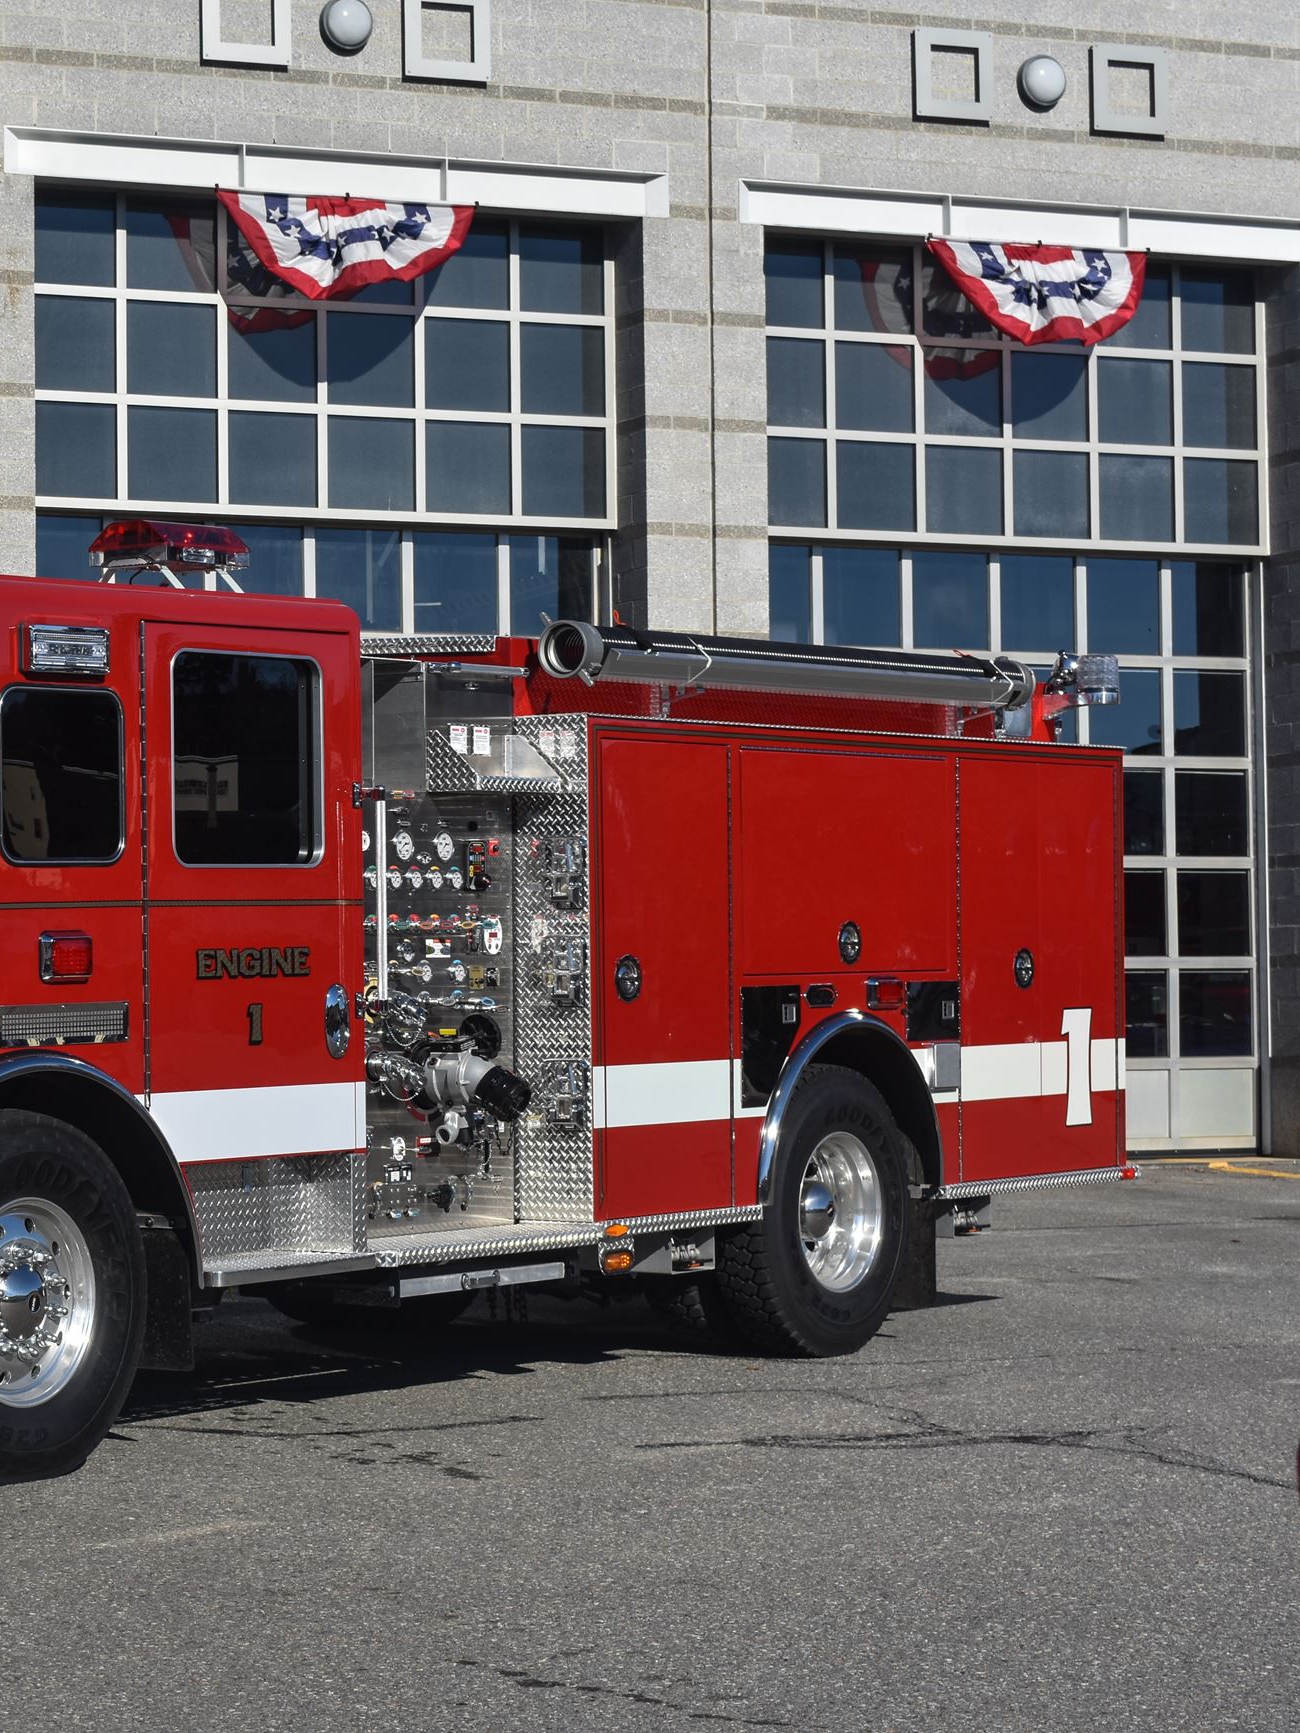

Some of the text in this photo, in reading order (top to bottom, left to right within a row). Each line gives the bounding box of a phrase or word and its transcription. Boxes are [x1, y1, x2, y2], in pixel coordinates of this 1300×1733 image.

[196, 946, 311, 980] ENGINE
[247, 1003, 264, 1045] 1
[1061, 1007, 1093, 1127] 1
